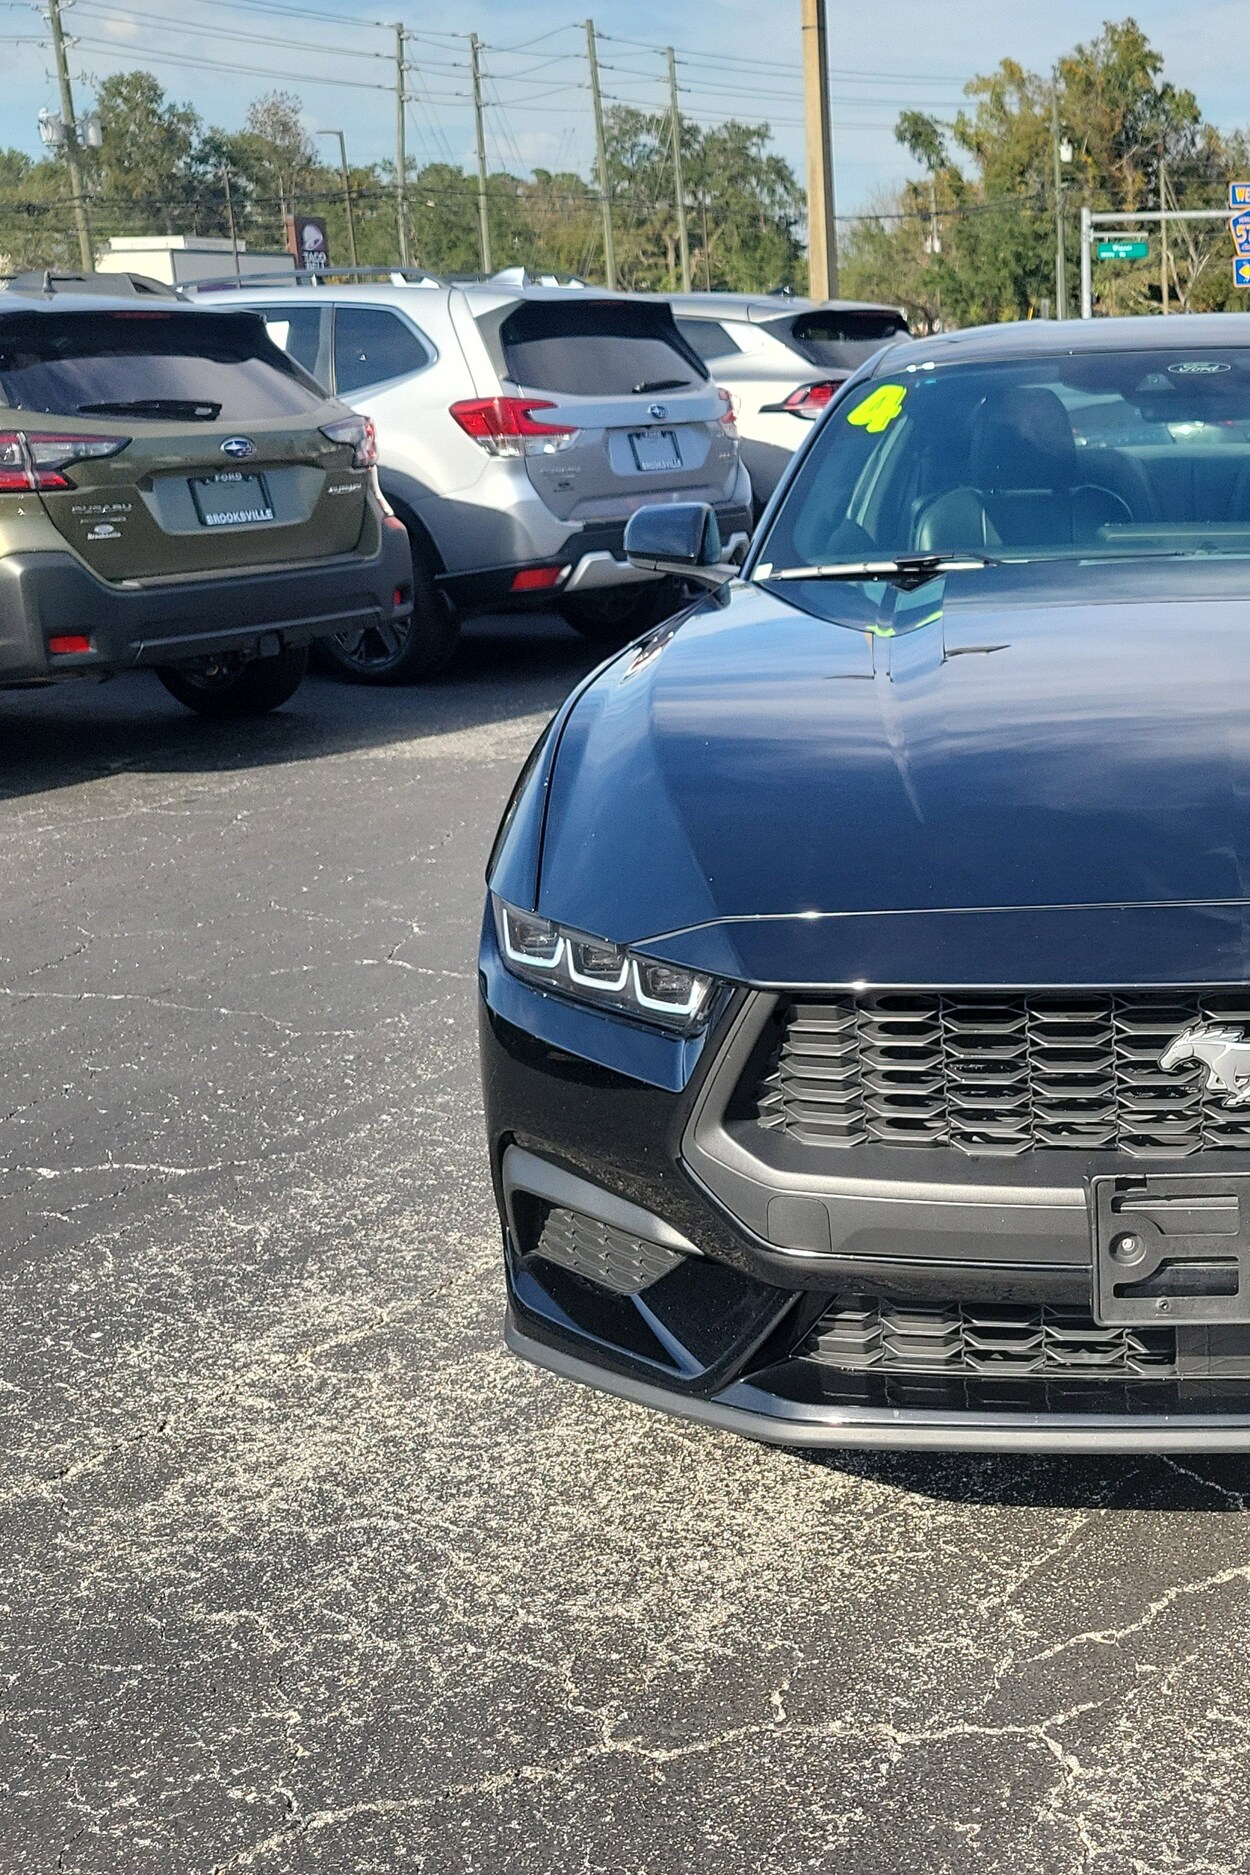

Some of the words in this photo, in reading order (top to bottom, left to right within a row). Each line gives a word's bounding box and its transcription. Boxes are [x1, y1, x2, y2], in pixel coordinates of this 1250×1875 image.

[1178, 363, 1220, 373] Ford
[846, 384, 907, 433] 4
[206, 507, 274, 526] BROOKSVILLE
